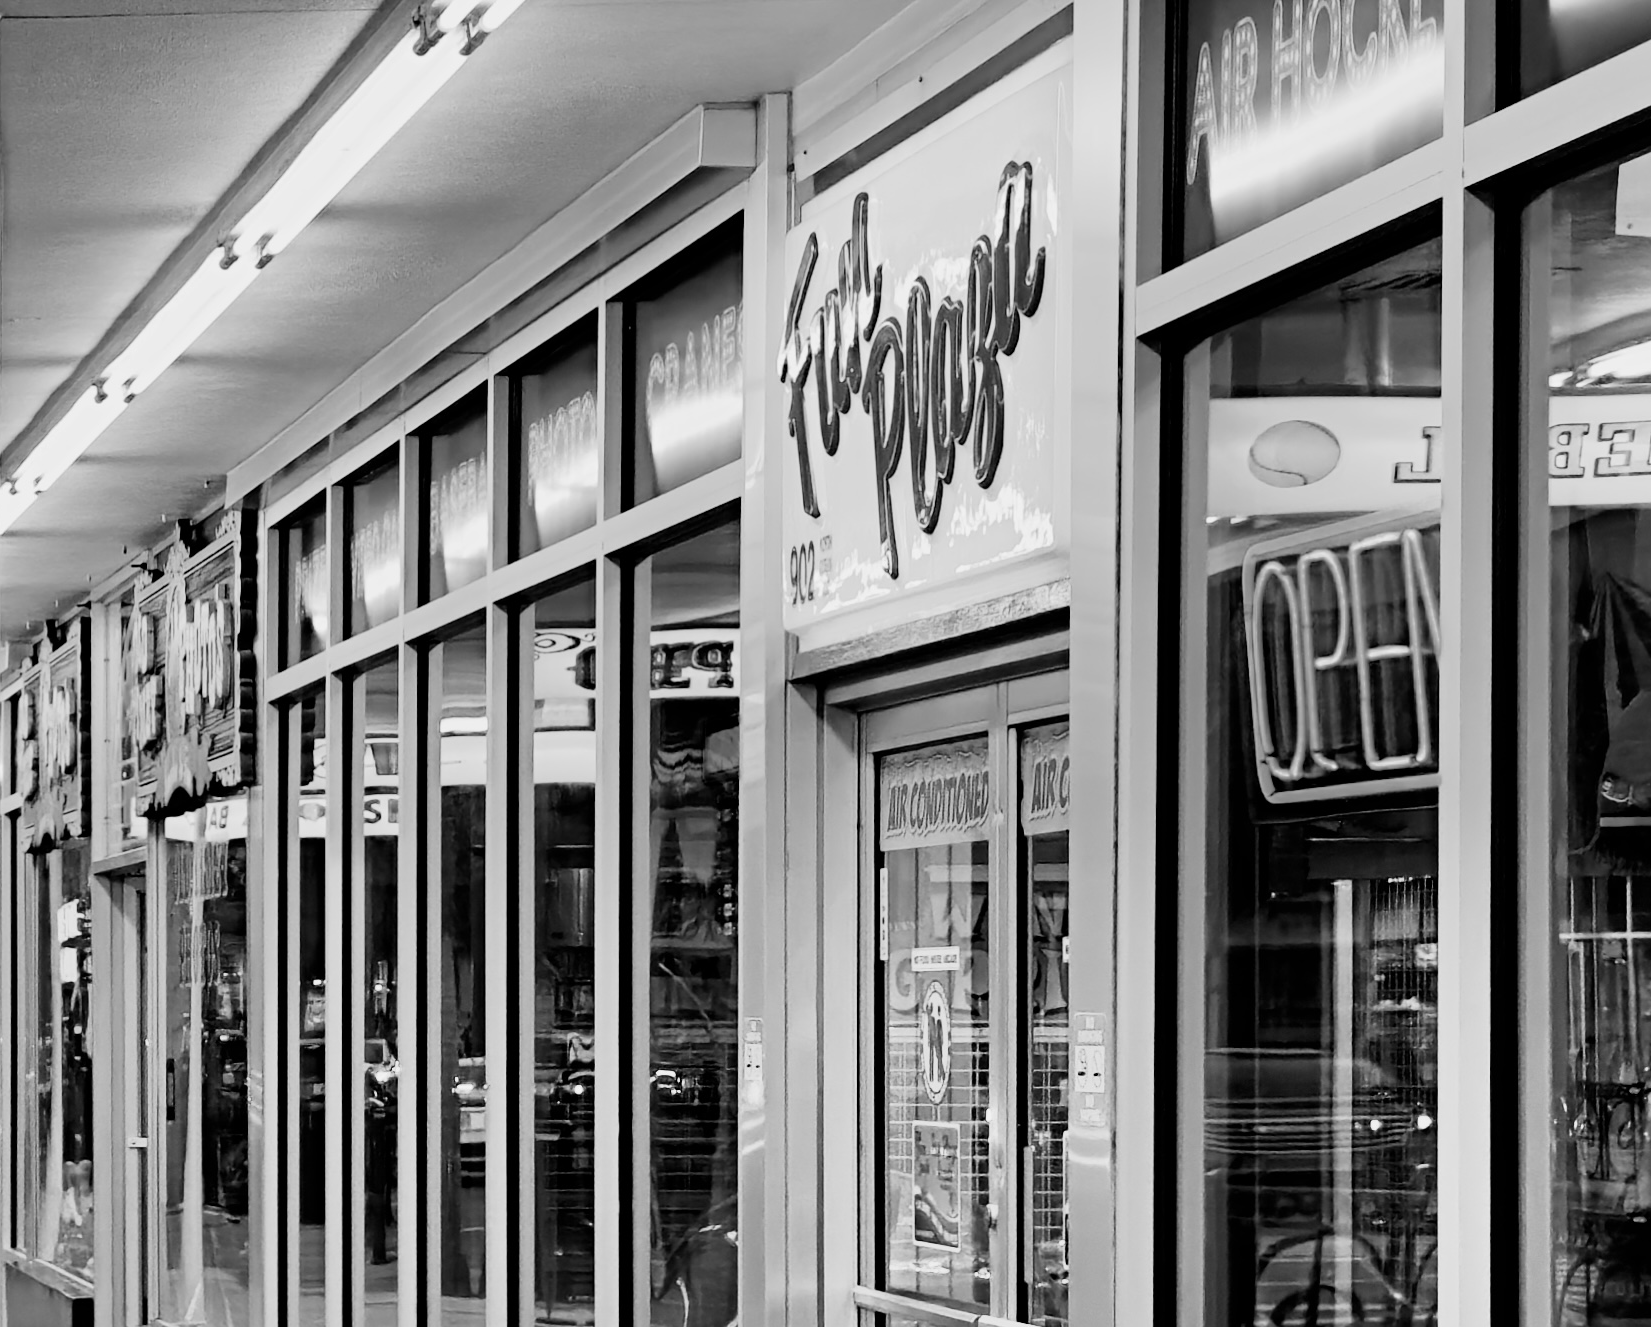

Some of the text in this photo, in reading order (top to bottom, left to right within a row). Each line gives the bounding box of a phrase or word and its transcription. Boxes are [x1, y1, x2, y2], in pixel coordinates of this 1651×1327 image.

[1186, 16, 1259, 185] AIR
[790, 540, 815, 607] 902
[887, 771, 989, 832] AIR CONDITIONED
[1031, 757, 1057, 814] AIR
